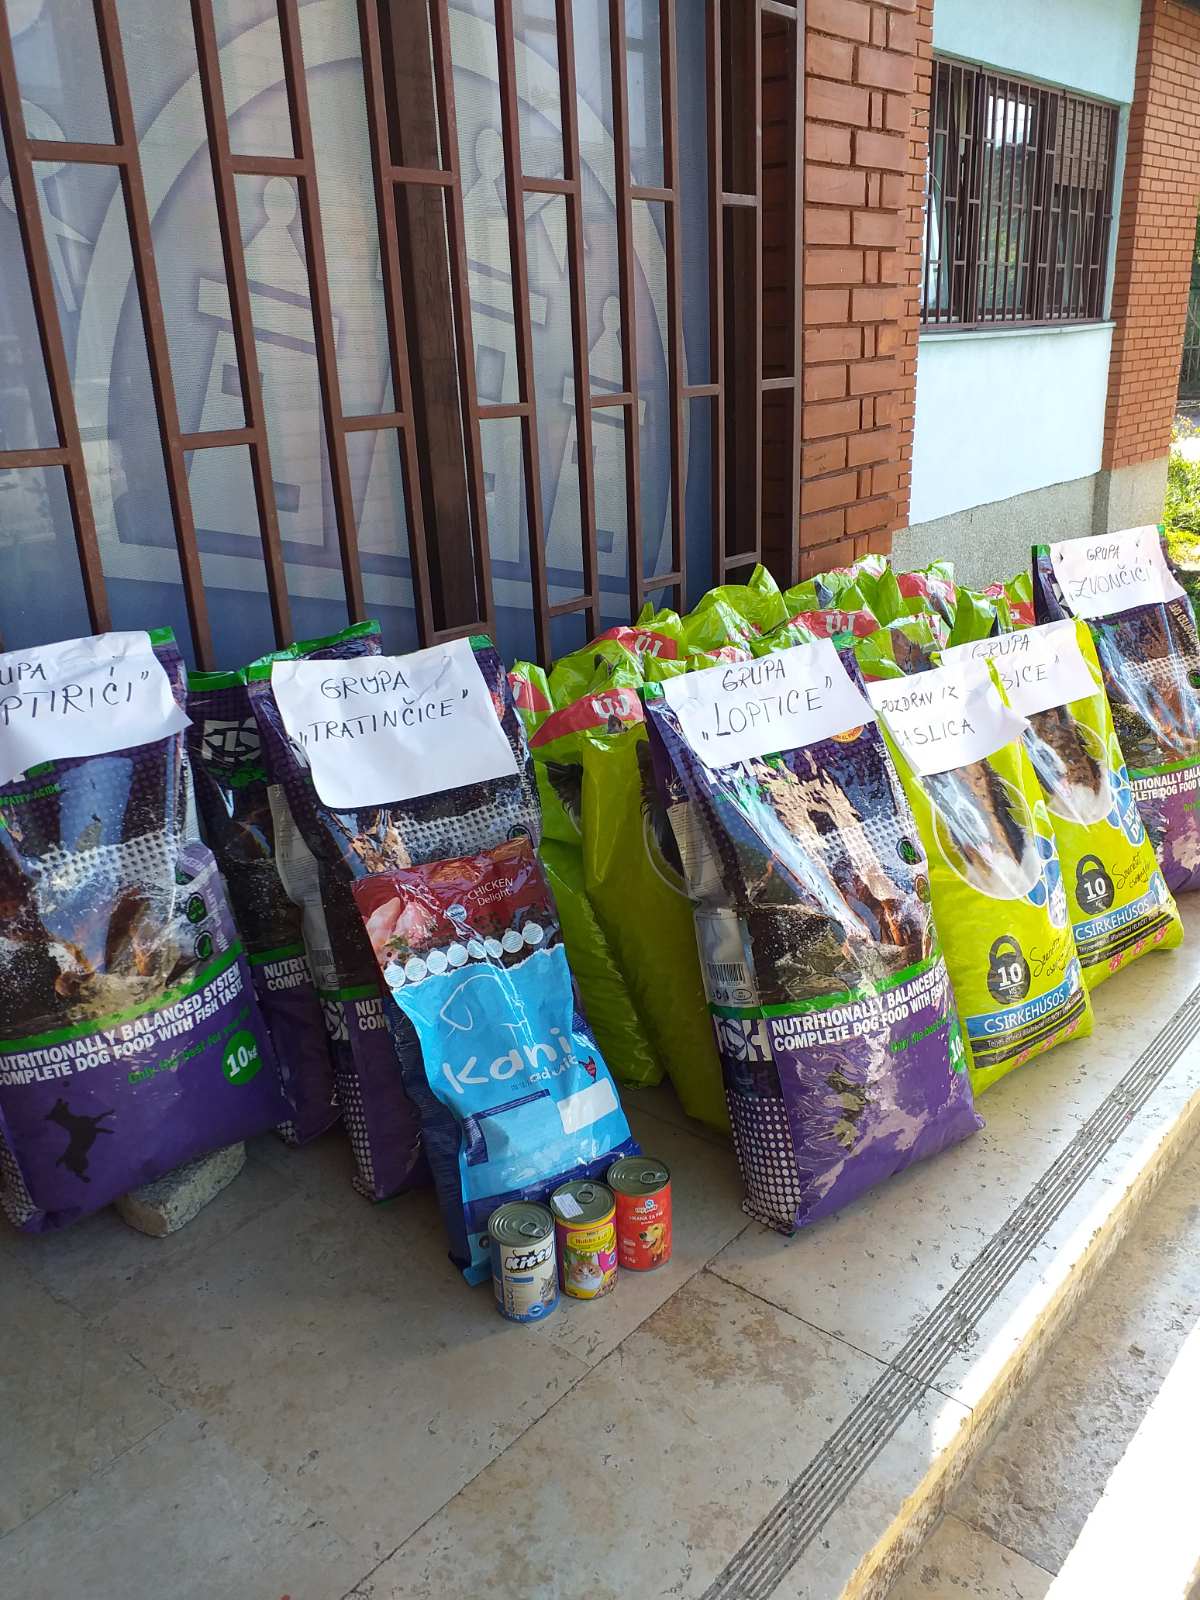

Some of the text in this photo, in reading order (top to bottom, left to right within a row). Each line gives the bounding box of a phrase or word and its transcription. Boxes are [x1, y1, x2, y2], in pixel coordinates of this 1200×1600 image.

[1087, 544, 1119, 560] GRUPA
[972, 634, 1030, 660] GRUPA
[320, 670, 410, 699] GRUPA
[722, 659, 786, 691] GRUPA
[881, 686, 960, 712] POZDRAV IZ
[467, 878, 513, 901] CHICKEN
[1084, 877, 1106, 900] 10
[1076, 898, 1149, 940] CSIRKEHÚSOS
[997, 962, 1022, 987] 10
[121, 994, 202, 1041] BALANCED
[203, 961, 241, 1002] SYSTEM
[771, 996, 884, 1036] NUTRITIONALLY
[887, 967, 935, 1009] BALANCED
[983, 988, 1065, 1033] CSIRKEHÚSOS
[75, 1049, 111, 1072] DOG
[113, 1033, 155, 1060] FOOD
[157, 1015, 195, 1042] WITH
[195, 999, 219, 1025] FISH
[773, 1029, 849, 1053] COMPLETE
[853, 1016, 880, 1035] DOG
[881, 1004, 909, 1027] FOOD
[909, 990, 931, 1014] WITH
[442, 1027, 573, 1094] Kani
